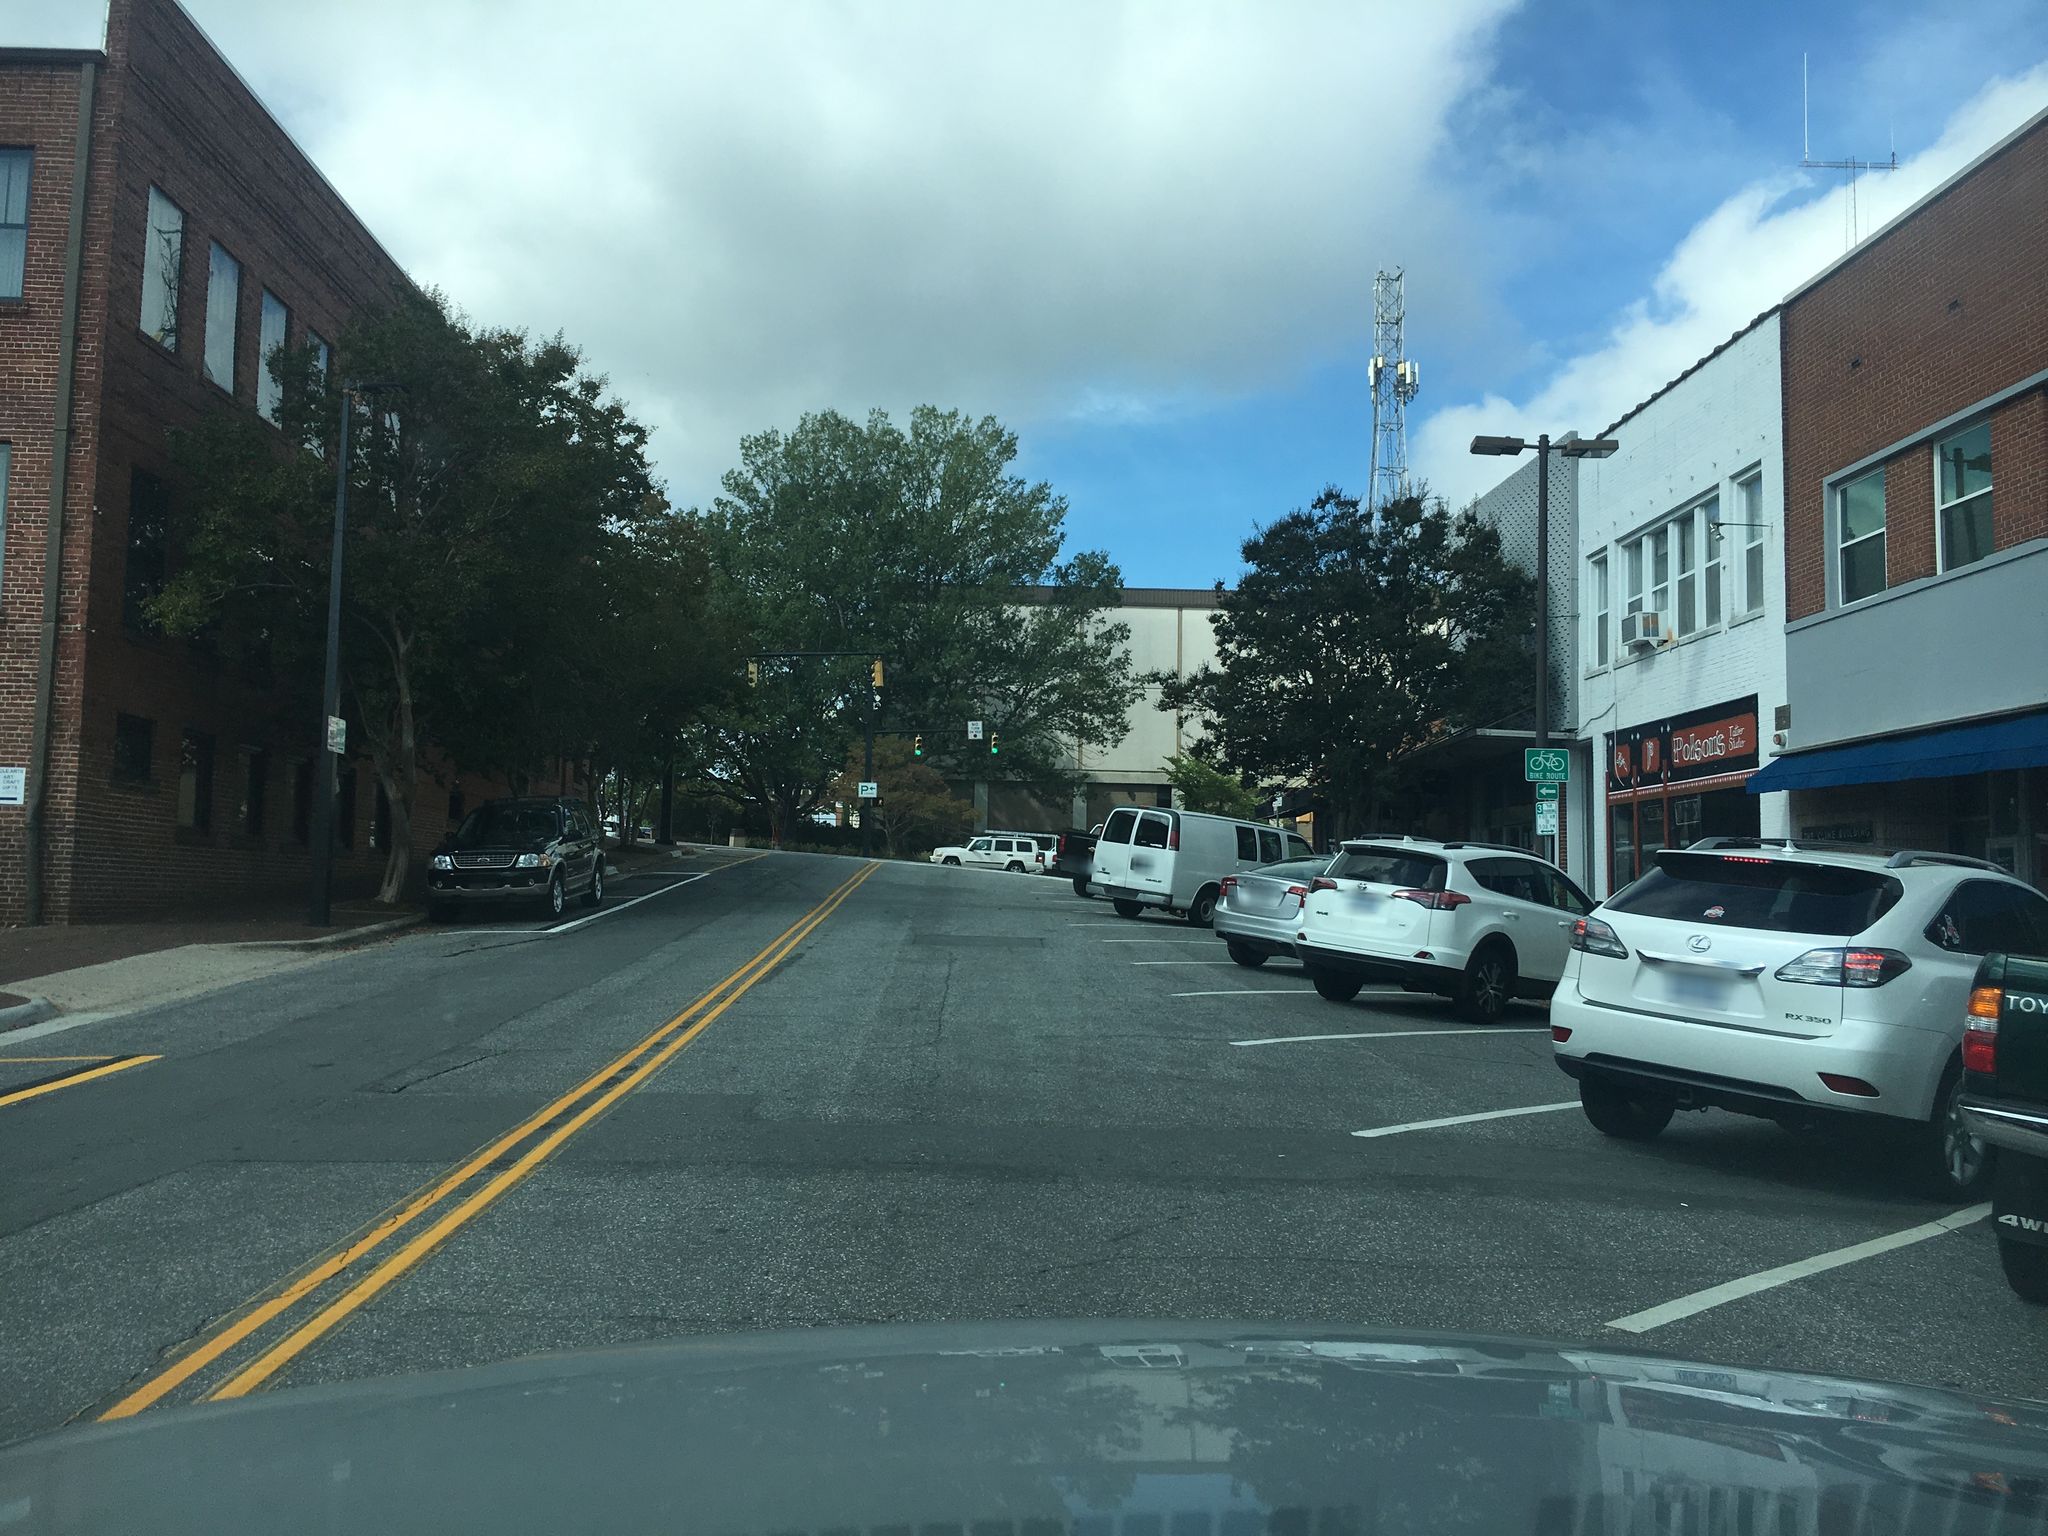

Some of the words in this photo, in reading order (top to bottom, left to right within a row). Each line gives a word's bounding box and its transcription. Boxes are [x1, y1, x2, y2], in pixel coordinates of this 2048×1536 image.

[1673, 730, 1725, 763] Polson's
[1529, 772, 1544, 780] BIKE
[1546, 772, 1566, 780] ROUTE
[861, 785, 869, 795] P
[1537, 804, 1543, 814] 3
[2005, 994, 2048, 1014] TOY
[1785, 1012, 1804, 1021] RX
[1804, 1015, 1832, 1025] 350
